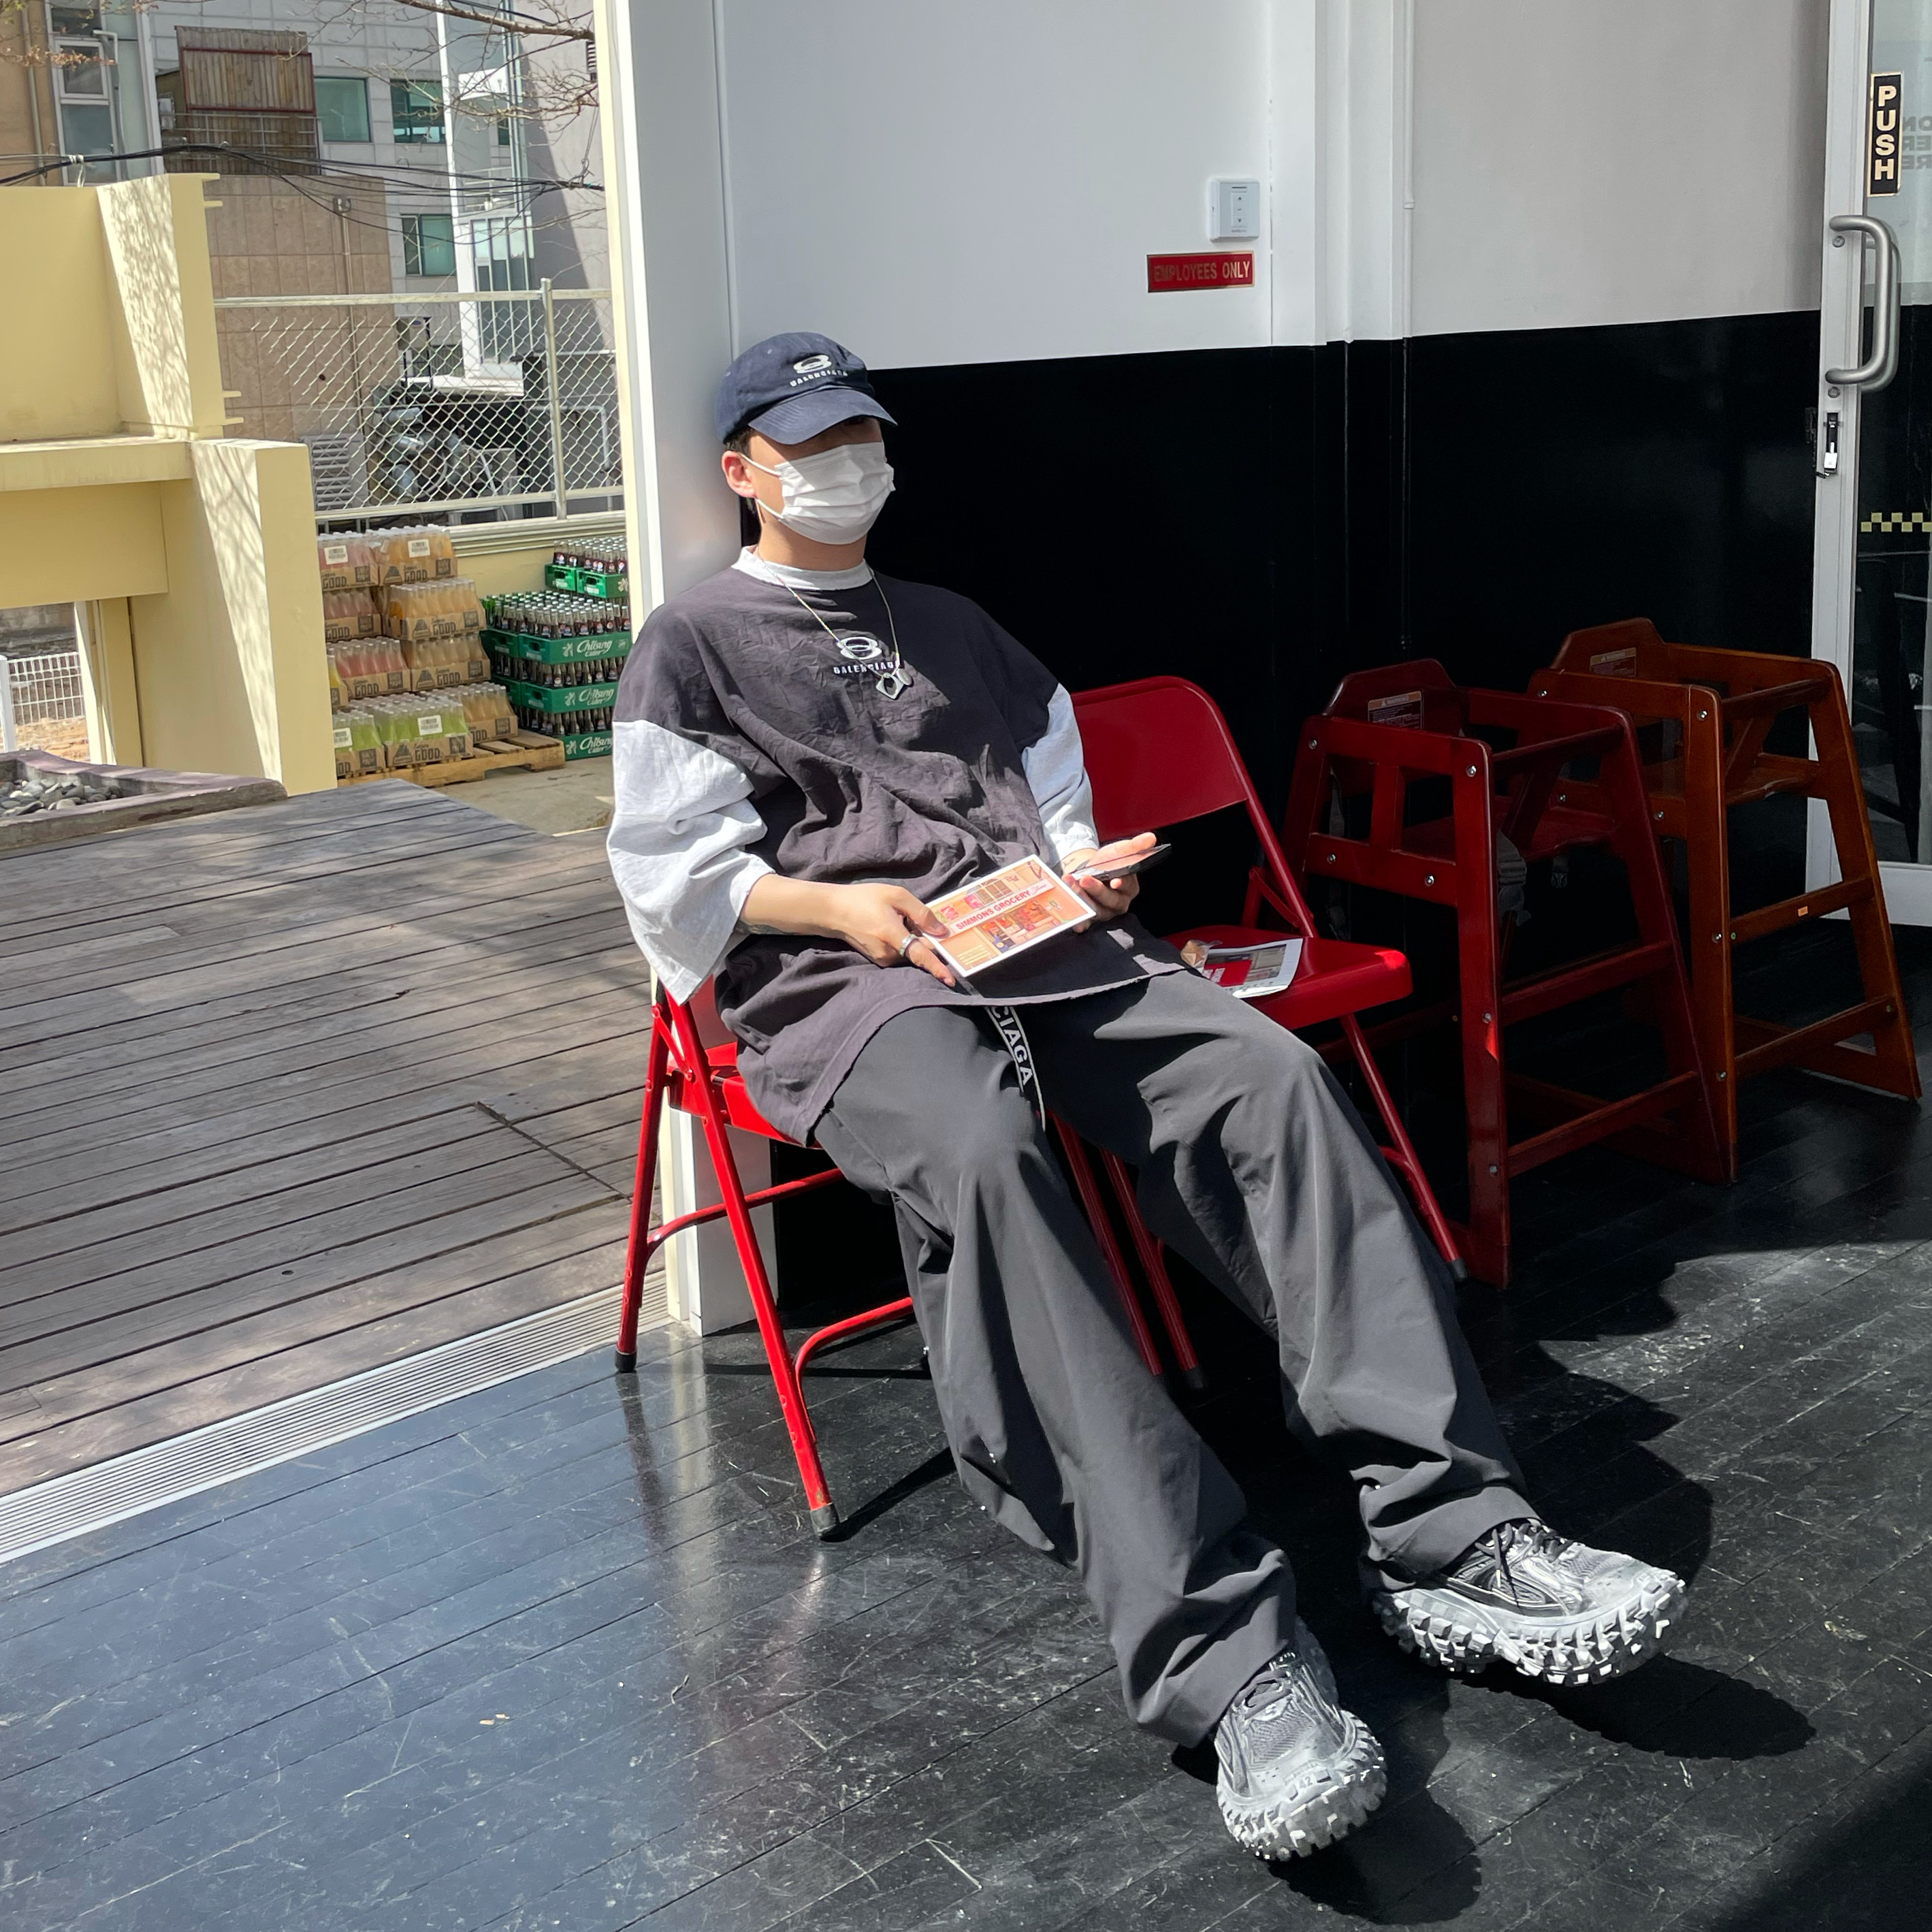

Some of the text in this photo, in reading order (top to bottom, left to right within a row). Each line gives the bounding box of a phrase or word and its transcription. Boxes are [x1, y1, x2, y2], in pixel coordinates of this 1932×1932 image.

[1874, 85, 1897, 180] PUSH
[1154, 261, 1250, 282] EMPLOYEES ONLY
[833, 660, 899, 675] BALENCIAG
[956, 908, 995, 930] SIMMONS
[993, 890, 1031, 912] GROCERY
